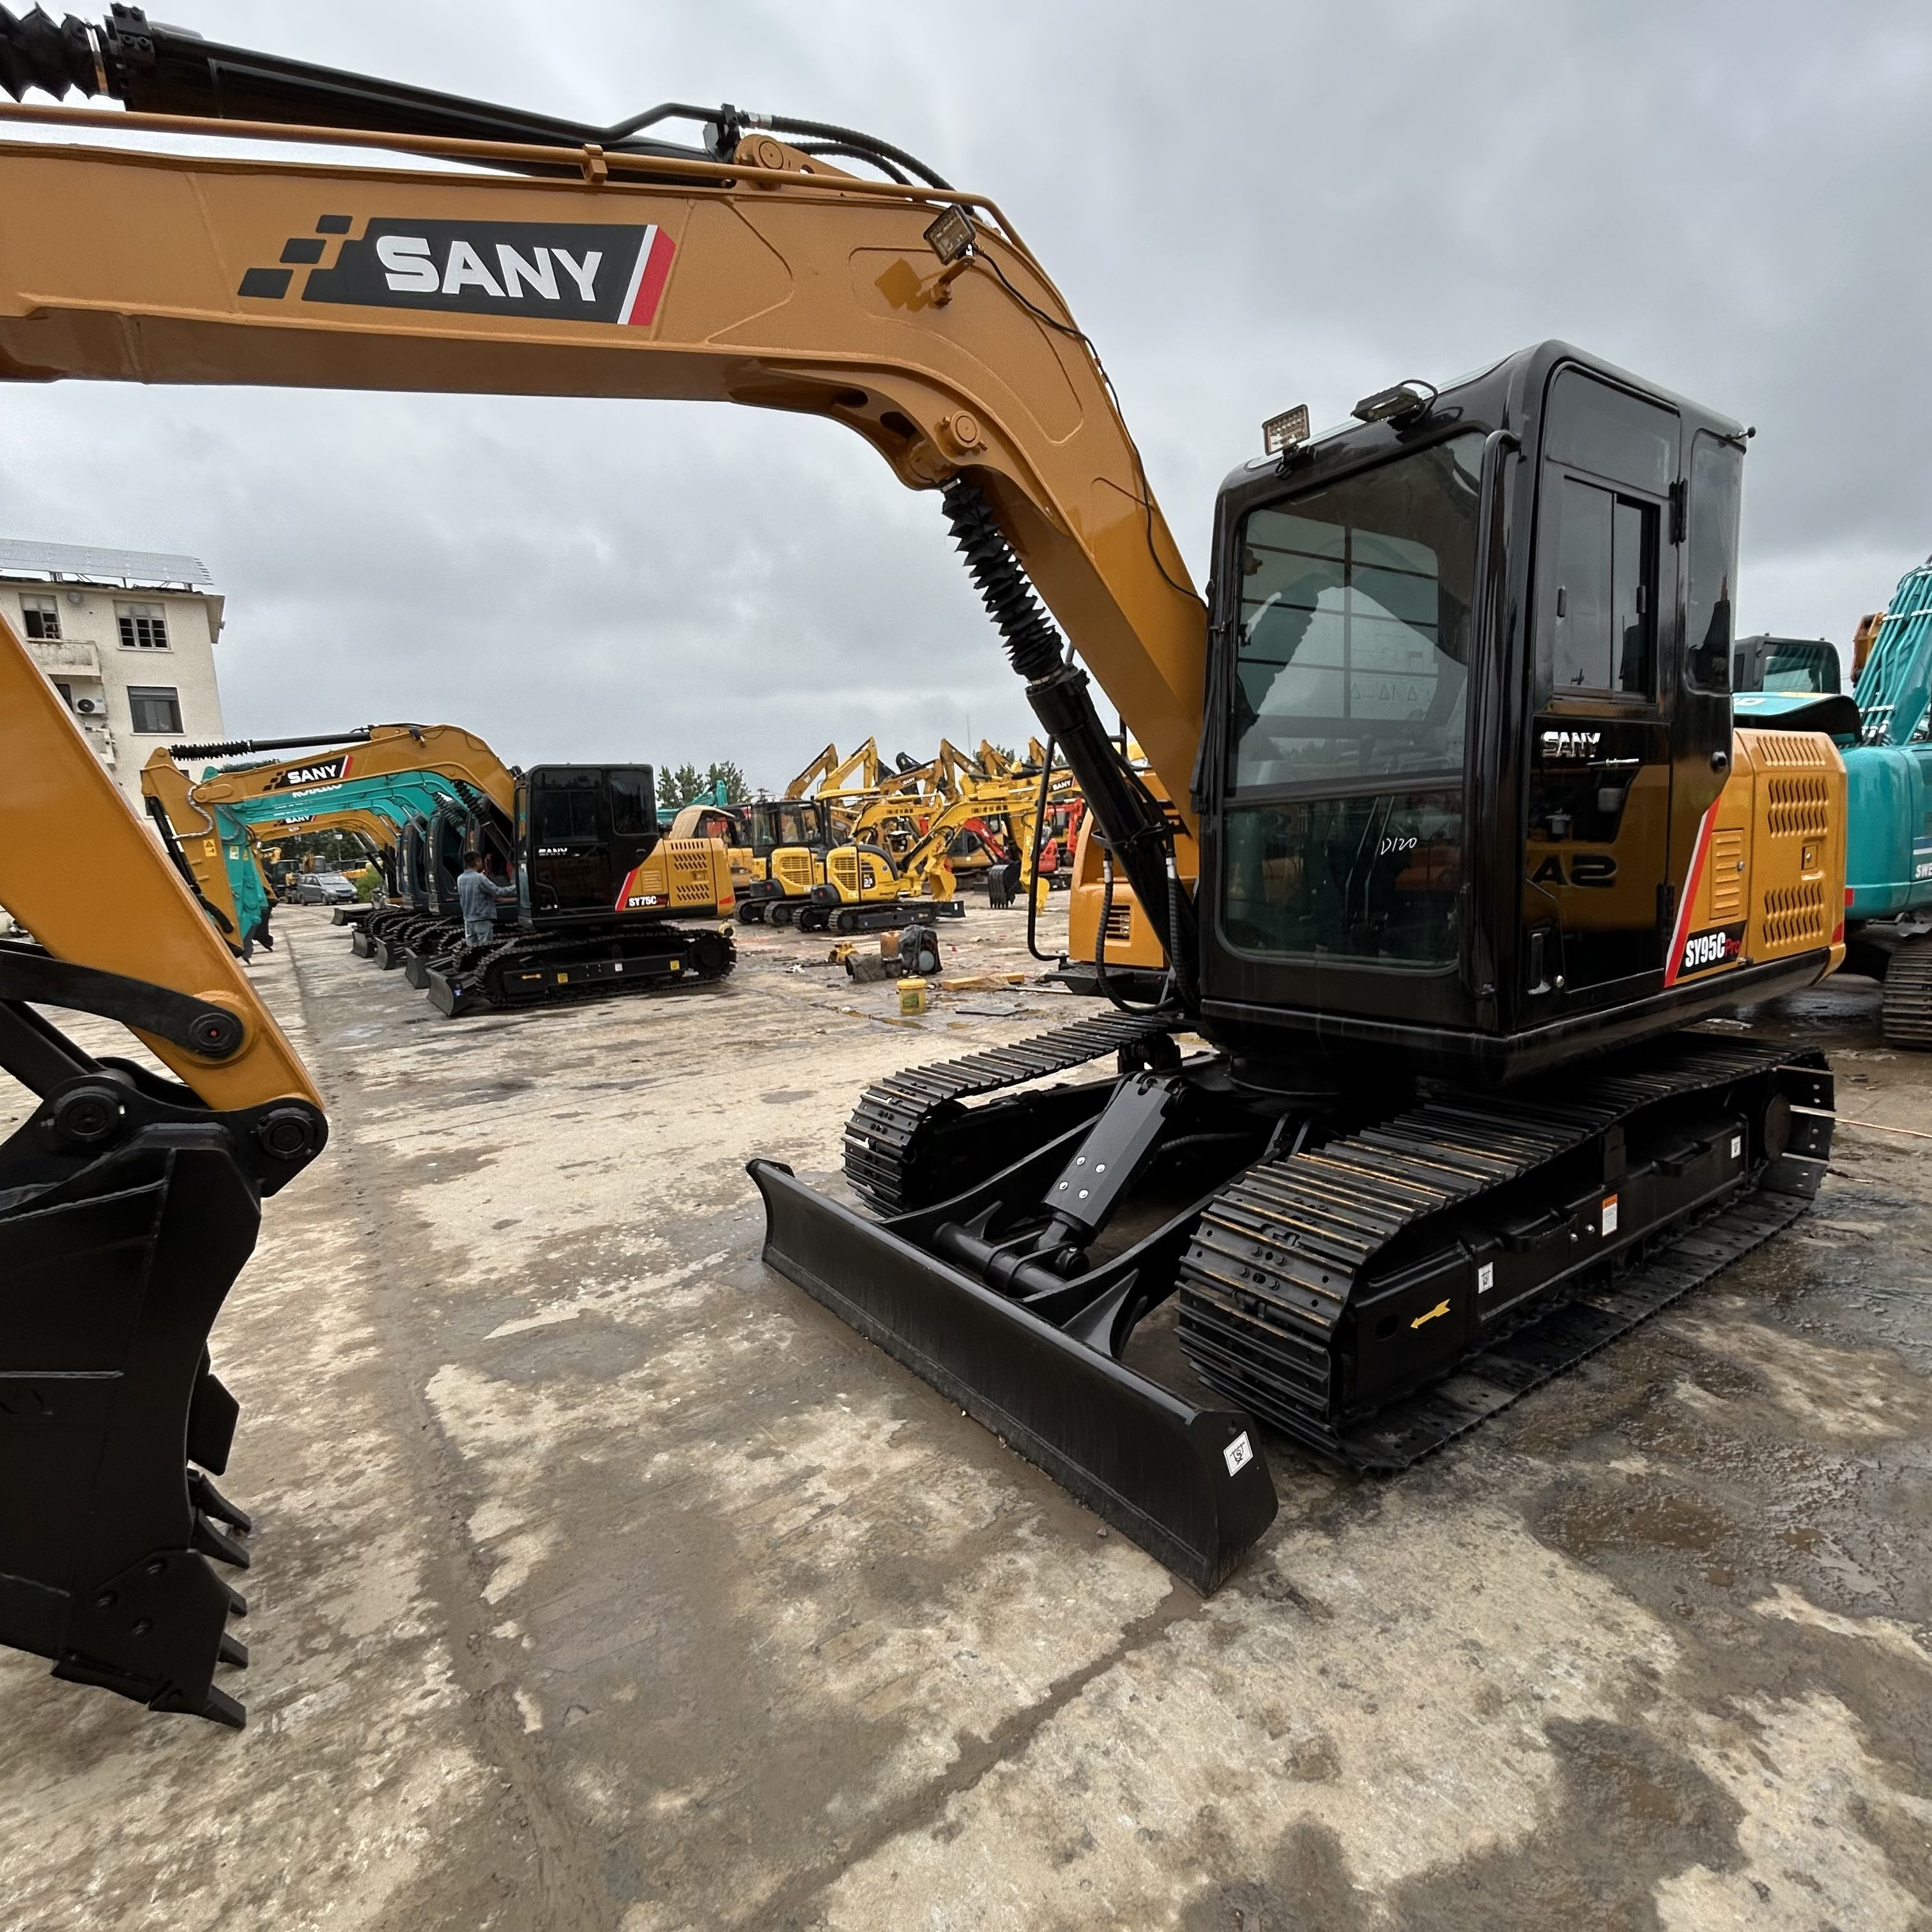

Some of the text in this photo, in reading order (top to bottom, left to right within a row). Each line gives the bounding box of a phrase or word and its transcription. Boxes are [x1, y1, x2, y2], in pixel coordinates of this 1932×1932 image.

[376, 235, 602, 302] SANY
[1541, 731, 1601, 758] SANY
[288, 765, 337, 784] SANY
[1053, 780, 1071, 791] SANY
[286, 815, 310, 824] SANY
[629, 896, 657, 907] SY75C
[1685, 931, 1740, 967] SY95C Pro
